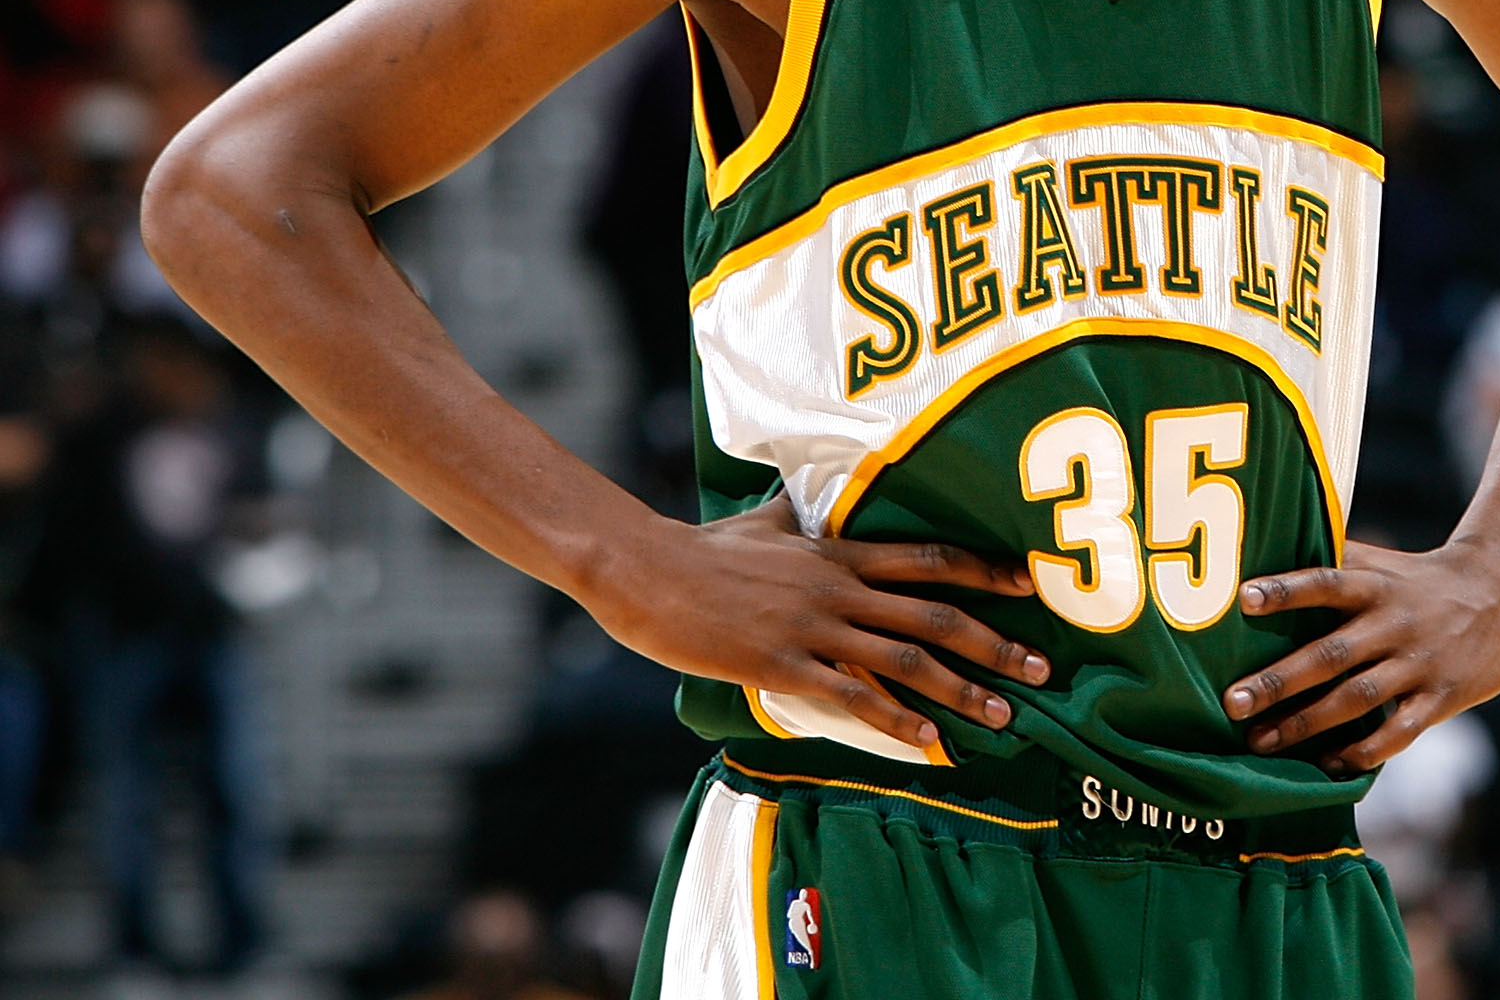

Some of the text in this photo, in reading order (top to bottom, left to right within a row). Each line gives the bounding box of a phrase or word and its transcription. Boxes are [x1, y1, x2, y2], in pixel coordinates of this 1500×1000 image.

[838, 155, 1330, 399] SEATTLE
[1018, 402, 1249, 634] 35
[787, 951, 810, 965] NBA
